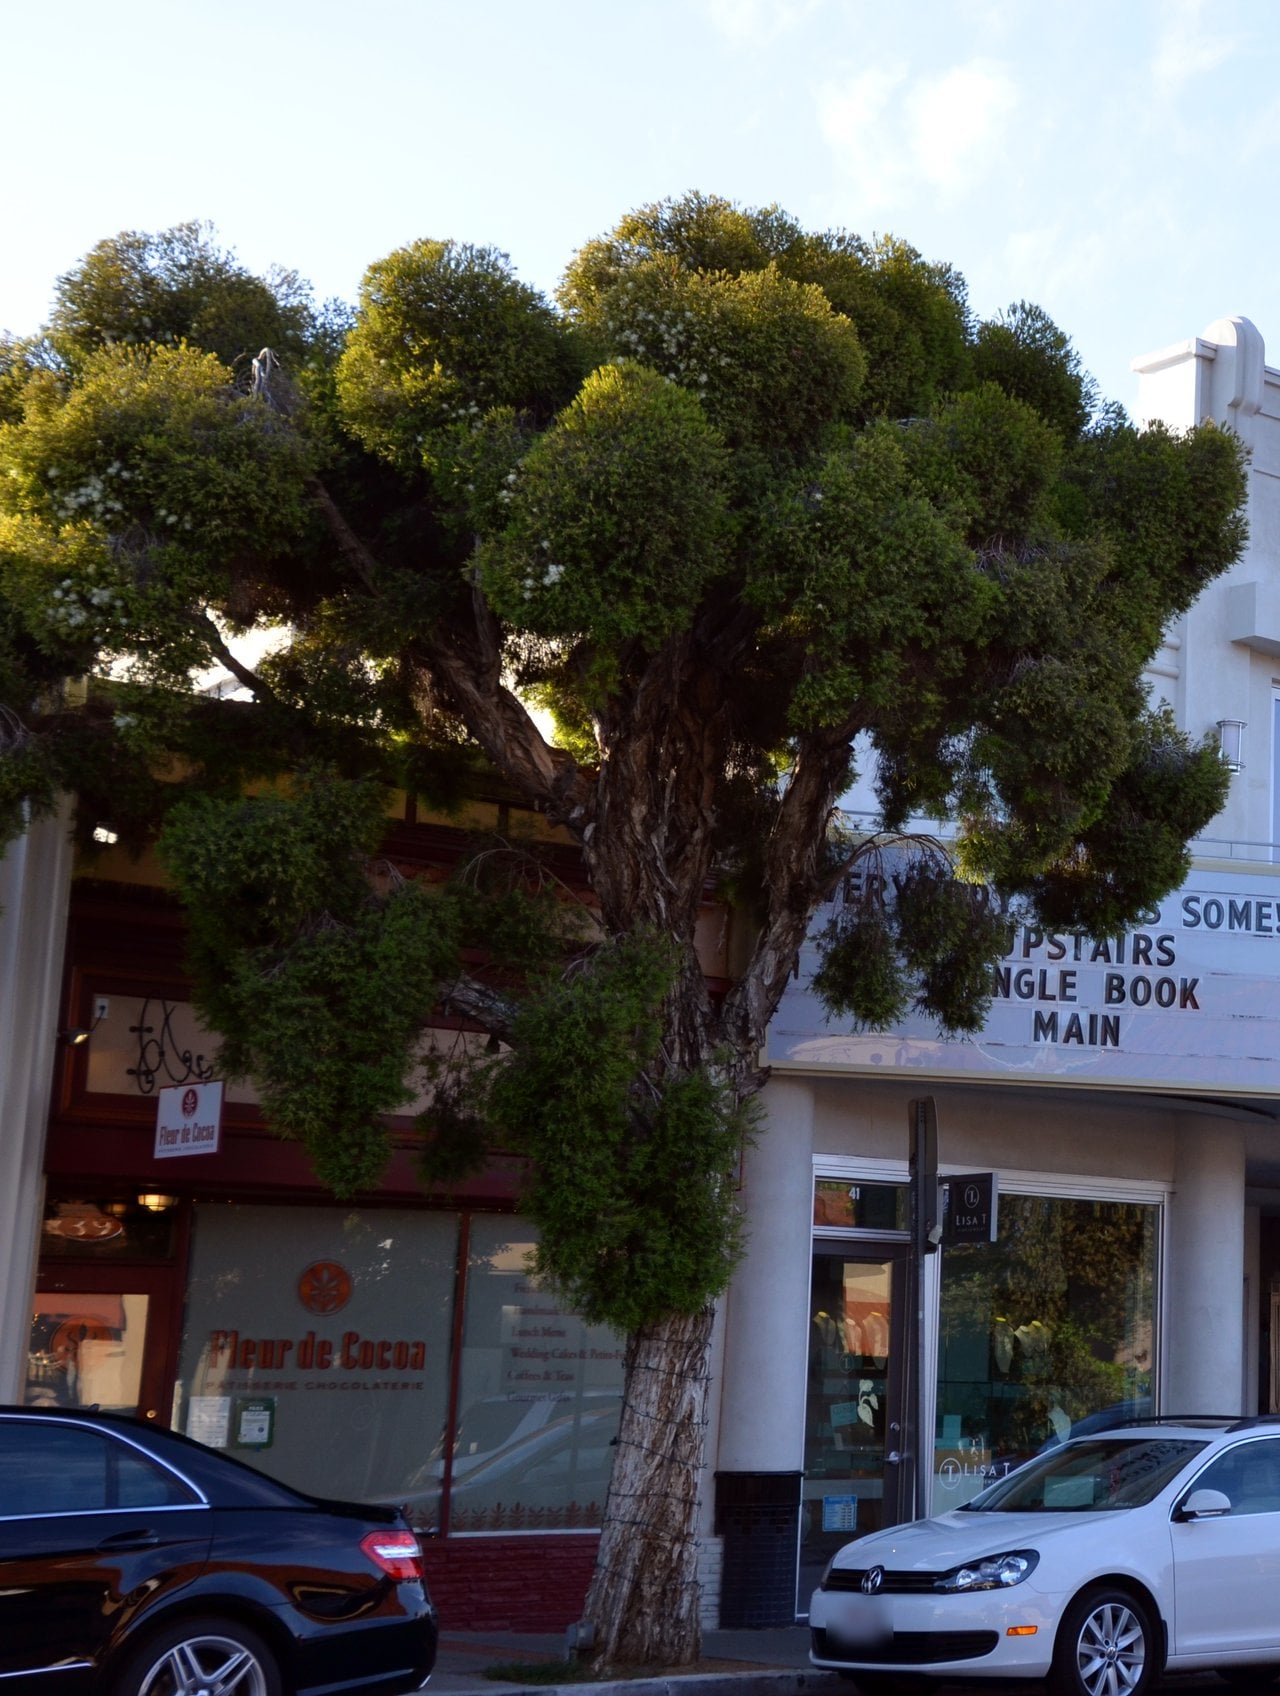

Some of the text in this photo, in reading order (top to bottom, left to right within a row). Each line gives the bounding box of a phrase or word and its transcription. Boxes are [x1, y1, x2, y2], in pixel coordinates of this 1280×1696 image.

[992, 966, 1200, 1010] NGLE BOOK
[1033, 1010, 1121, 1047] MAIN
[159, 1122, 215, 1146] Fleur de Cocoa
[848, 1187, 860, 1200] 41
[208, 1328, 426, 1371] Fleur de Cocoa
[303, 1380, 424, 1391] CHOCOLATERIE
